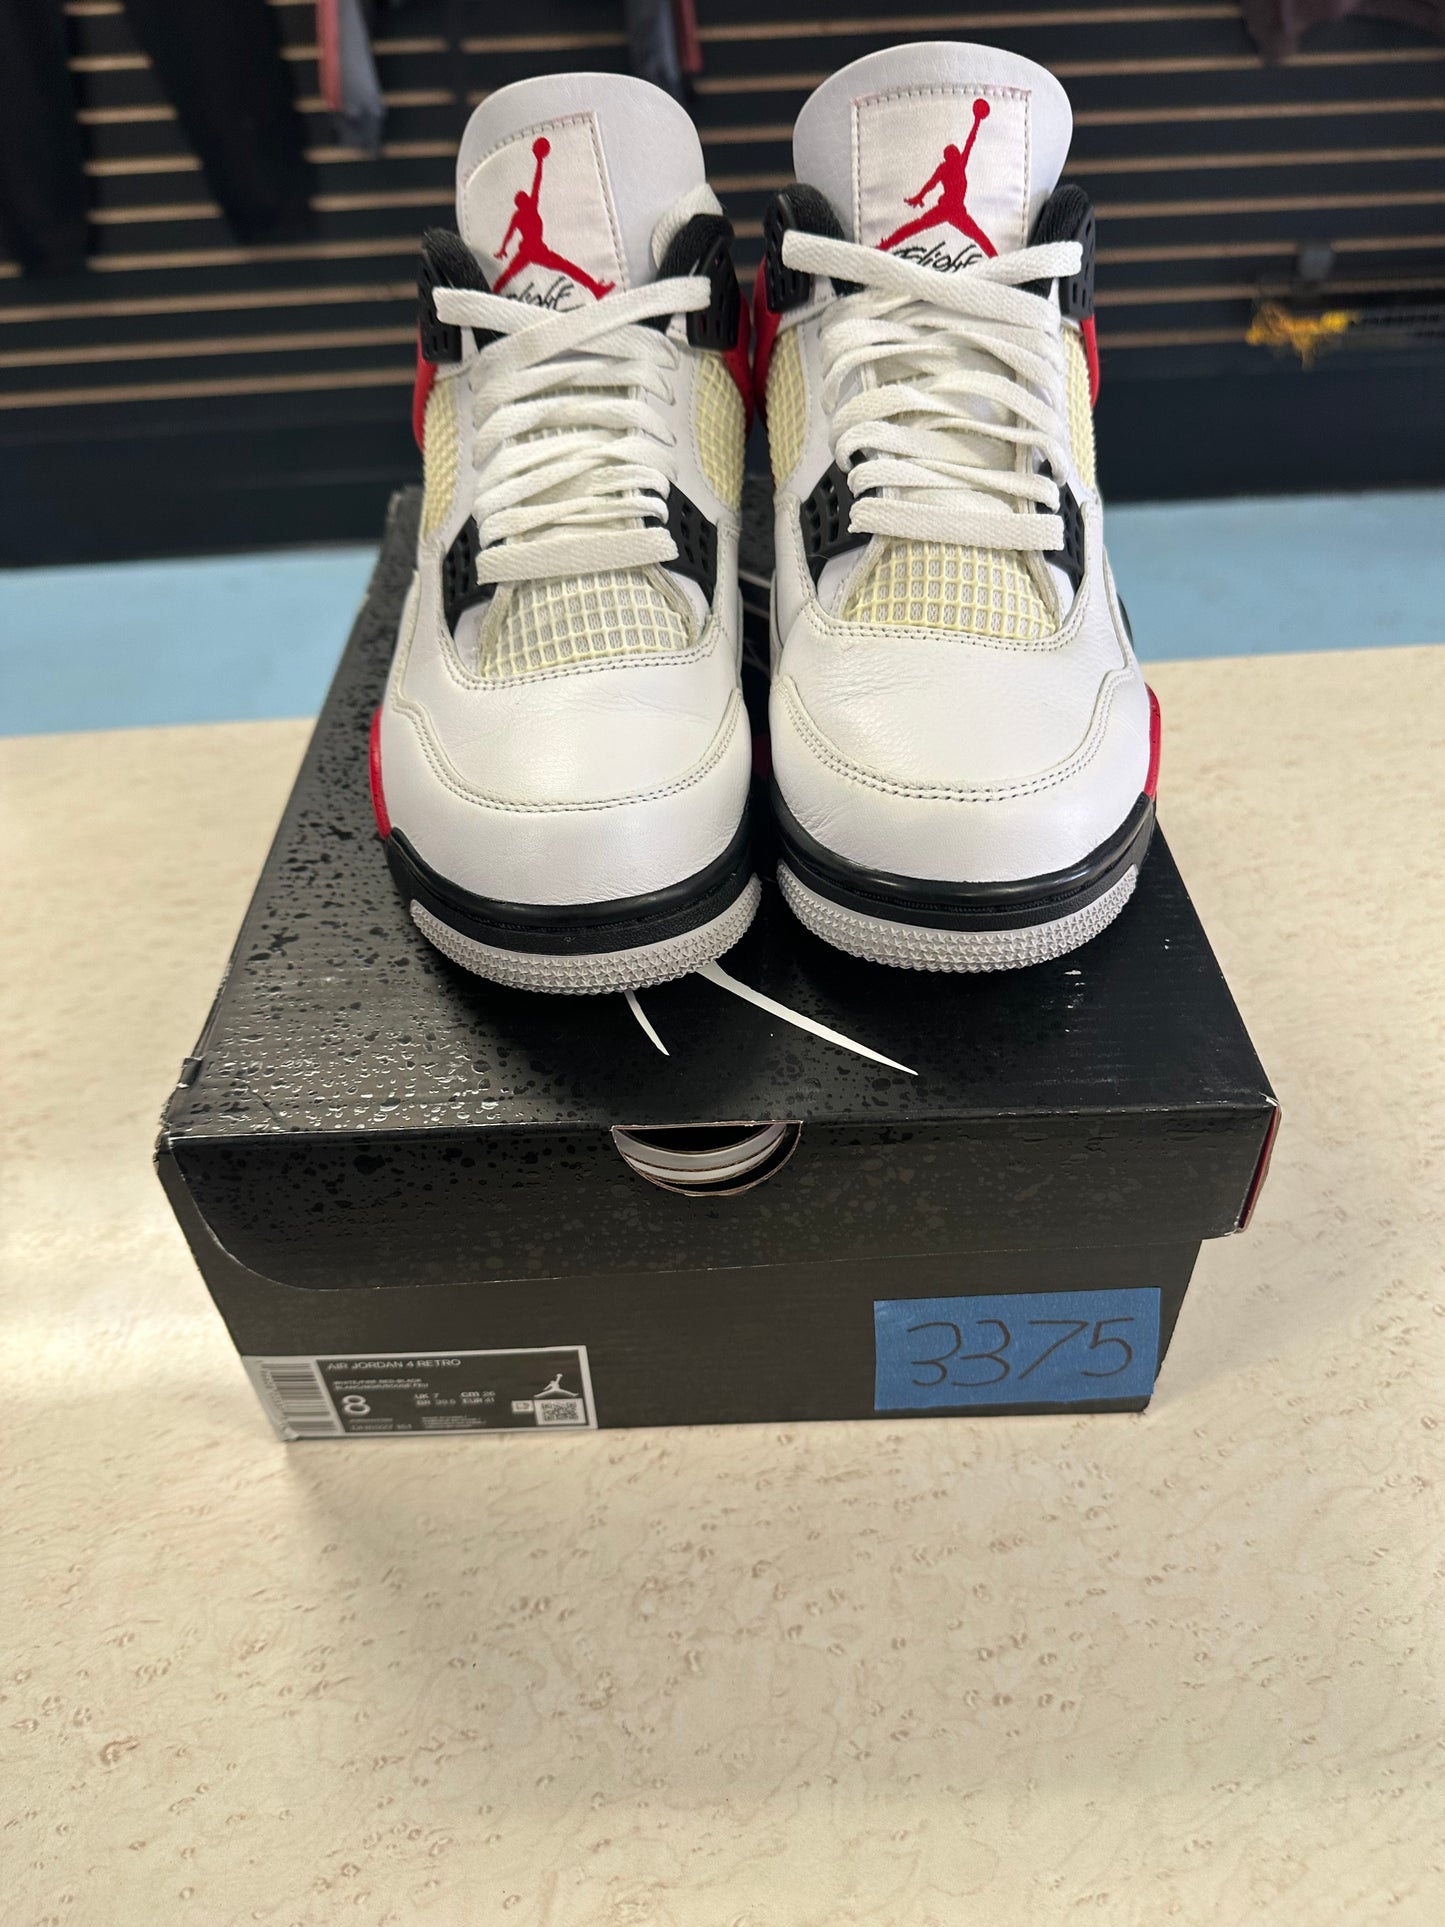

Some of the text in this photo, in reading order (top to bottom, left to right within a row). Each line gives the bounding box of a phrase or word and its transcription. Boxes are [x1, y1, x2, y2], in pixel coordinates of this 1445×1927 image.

[907, 1317, 1135, 1387] 3375
[327, 1362, 348, 1370] AIR
[351, 1361, 404, 1370] JORDAN
[417, 1359, 462, 1367] RETRO
[342, 1395, 371, 1415] 8
